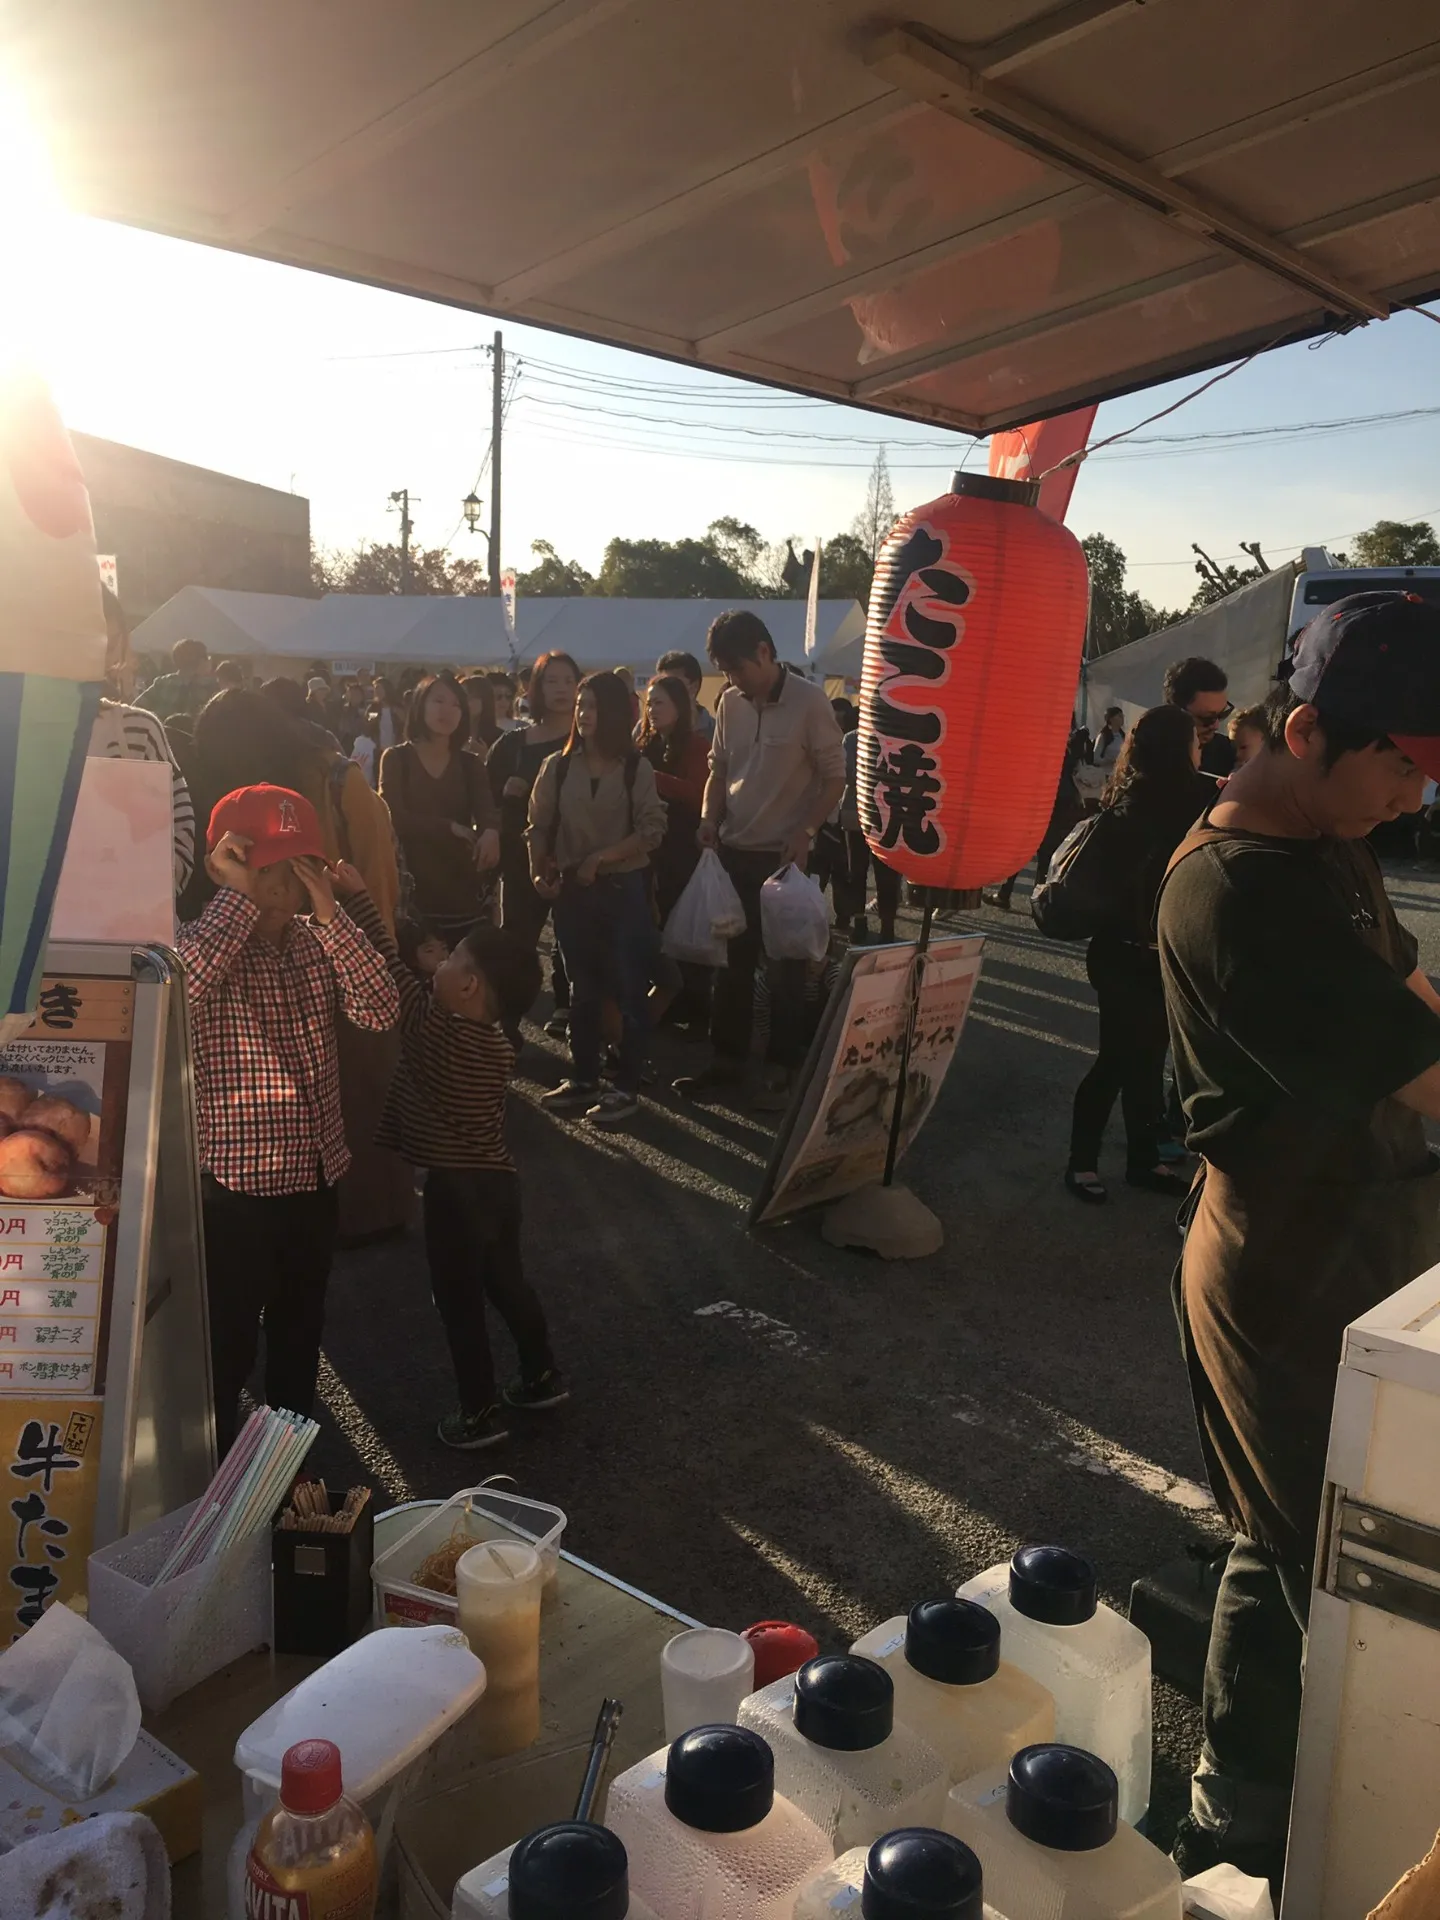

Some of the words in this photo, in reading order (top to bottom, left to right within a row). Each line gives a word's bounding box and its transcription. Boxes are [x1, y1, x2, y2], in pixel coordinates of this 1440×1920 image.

[30, 983, 82, 1029] き
[0, 1044, 94, 1056] は付いておりません。
[53, 1210, 83, 1218] ソース
[43, 1218, 92, 1227] マヨネーズ
[0, 1254, 23, 1270] 円
[40, 1254, 90, 1263] マヨネーズ
[34, 1326, 84, 1335] マヨネーズ
[30, 1372, 79, 1380] マヨネーズ
[10, 1421, 81, 1642] 牛たま
